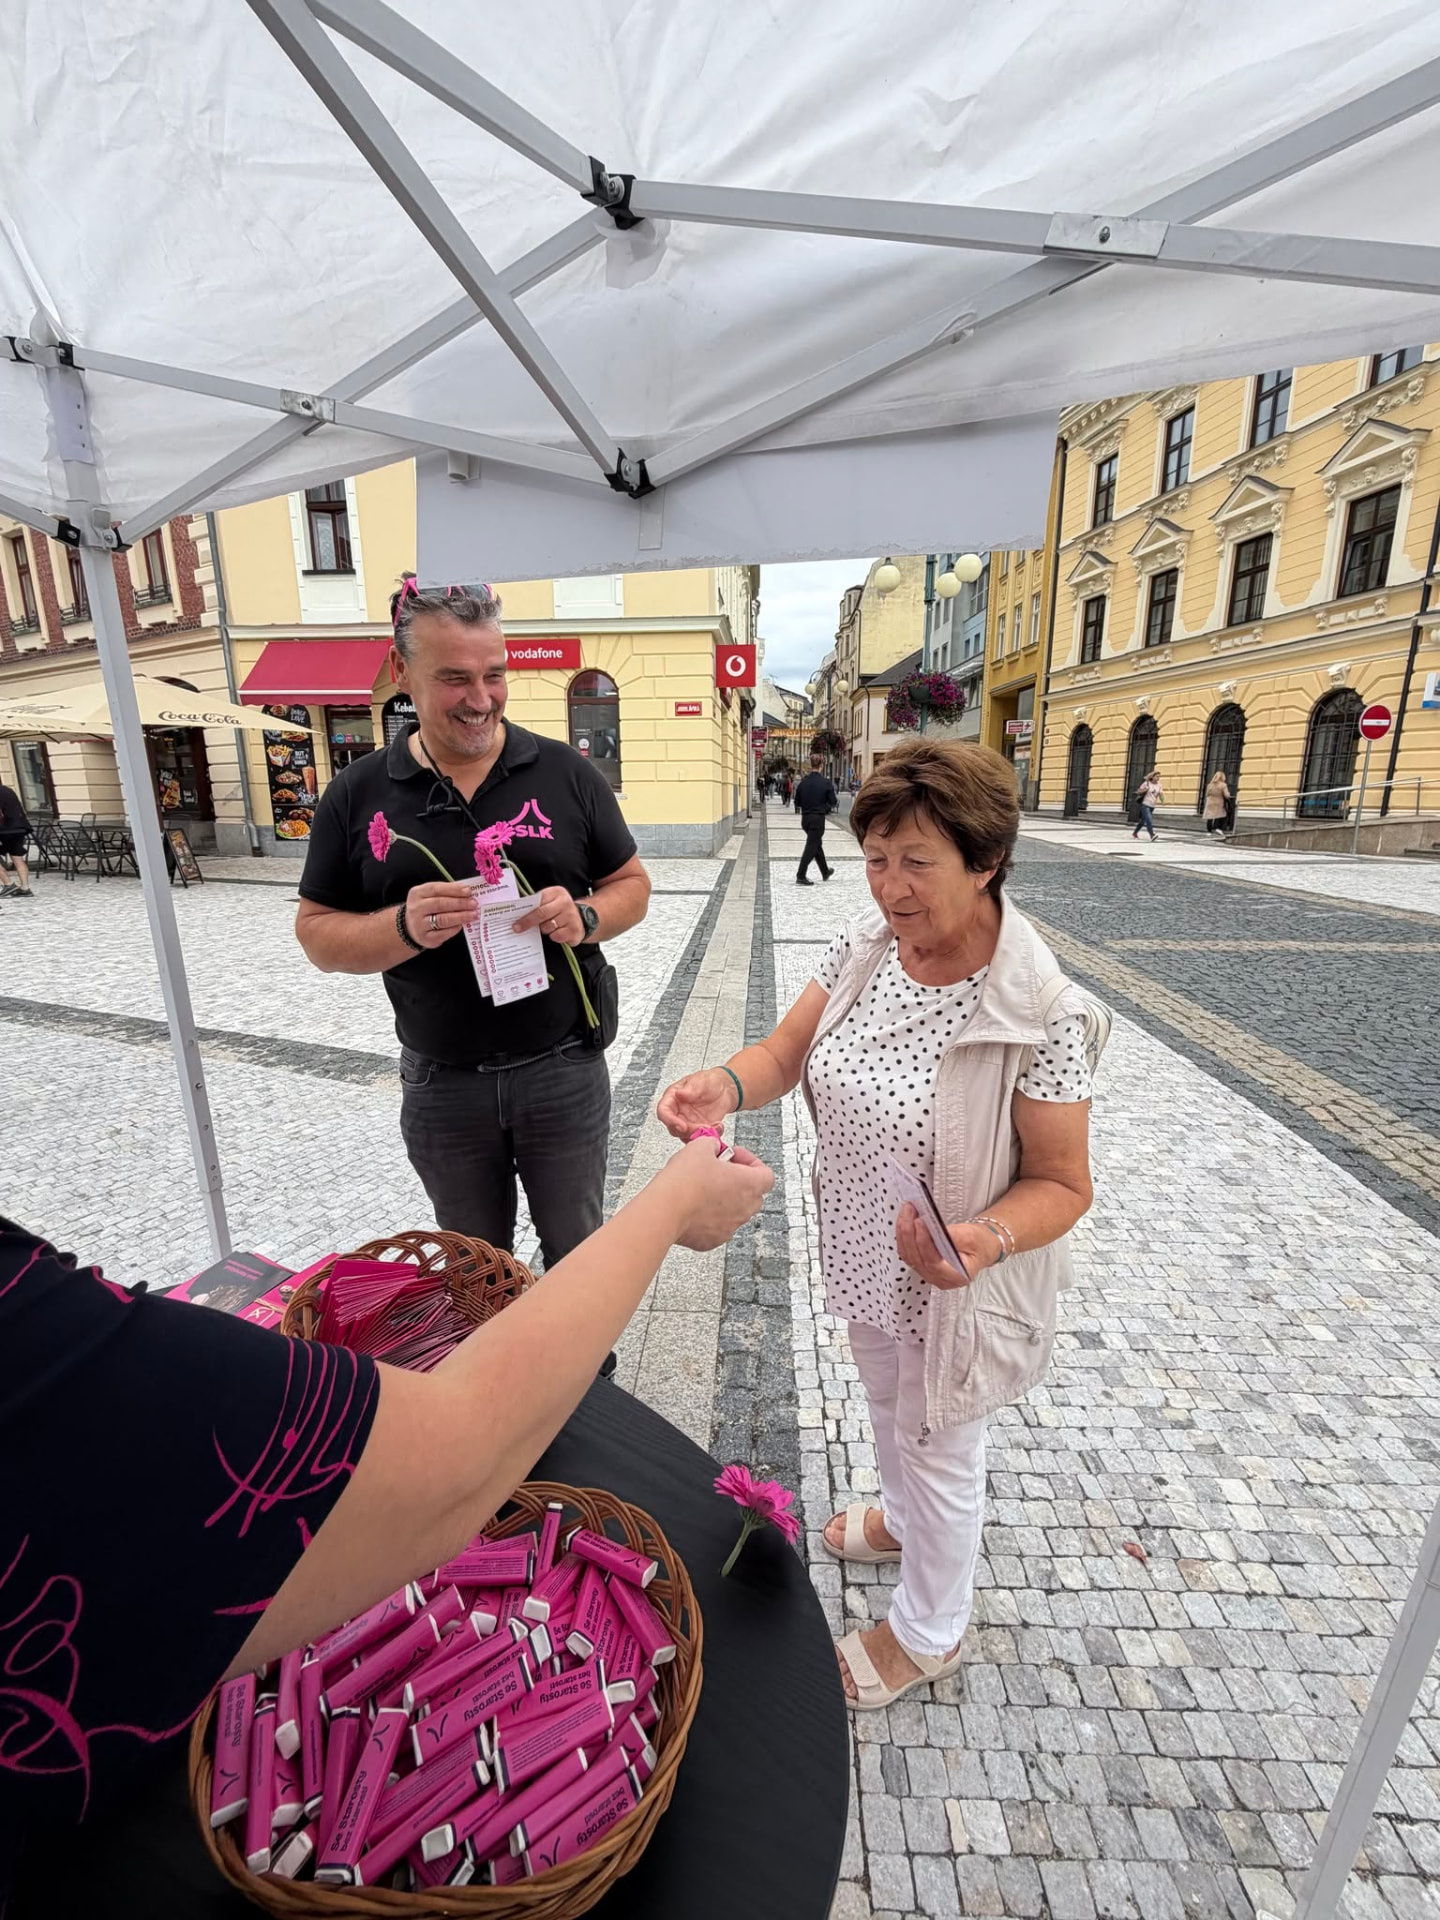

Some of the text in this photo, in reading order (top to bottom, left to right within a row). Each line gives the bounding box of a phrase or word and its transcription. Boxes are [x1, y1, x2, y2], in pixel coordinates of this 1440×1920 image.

[511, 647, 563, 659] vodafone
[158, 710, 242, 725] Coca-Cola
[514, 825, 554, 840] SLK
[587, 1588, 599, 1617] Starosty
[501, 1671, 515, 1684] bez
[577, 1670, 591, 1681] bez
[464, 1680, 518, 1721] Se Starosty
[540, 1679, 592, 1703] Se Starosty
[331, 1770, 367, 1851] Se Starosty
[576, 1798, 629, 1846] Se Starosty
